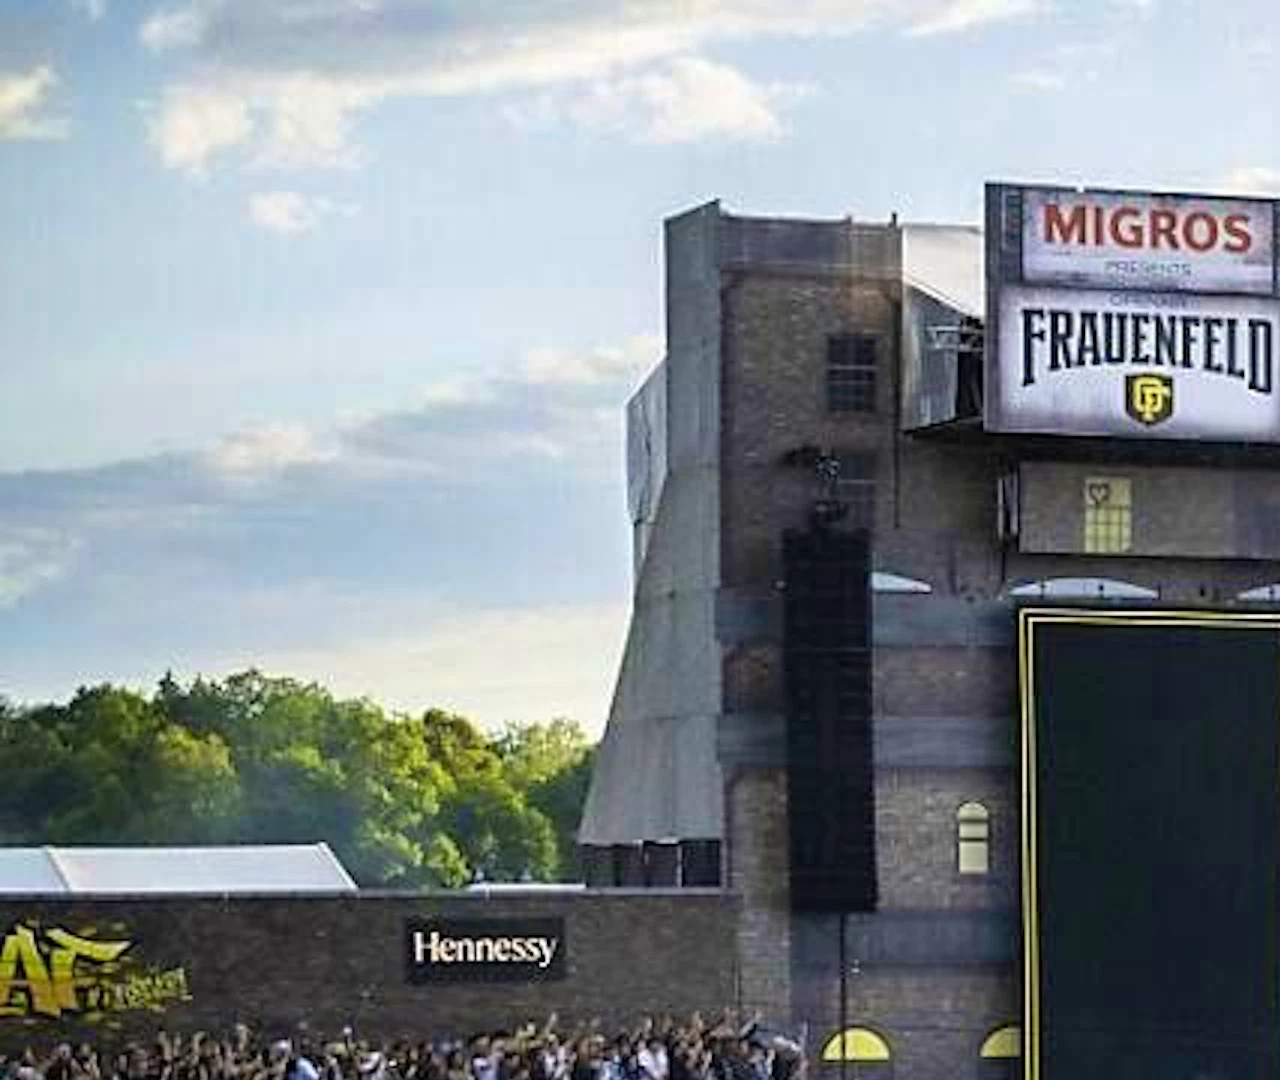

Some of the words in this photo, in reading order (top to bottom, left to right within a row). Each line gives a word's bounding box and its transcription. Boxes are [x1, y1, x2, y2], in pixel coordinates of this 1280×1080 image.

[1043, 204, 1252, 253] MIGROS
[1021, 308, 1272, 394] FRAUENFELD
[413, 931, 557, 968] Hennessy
